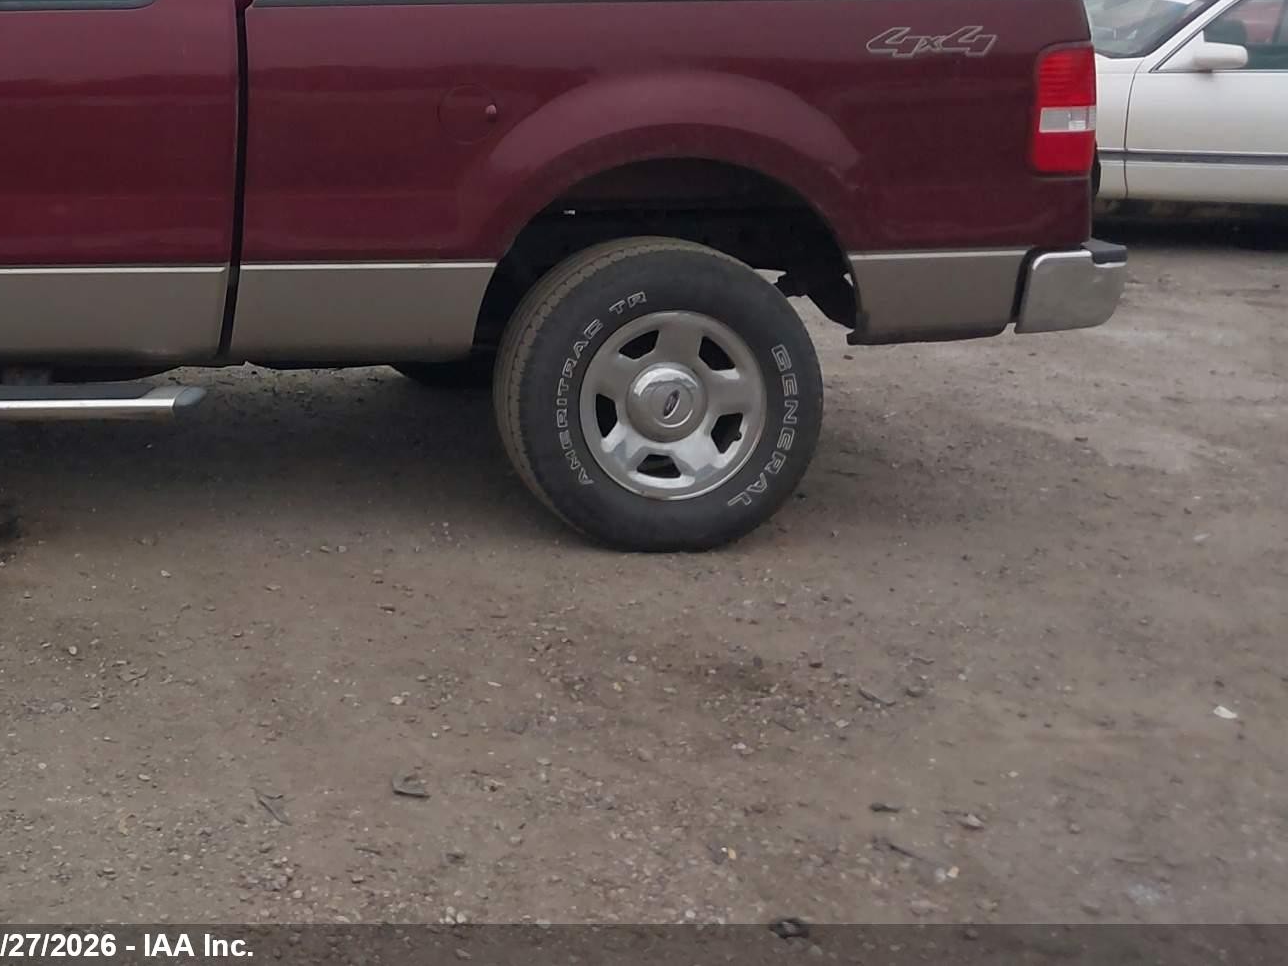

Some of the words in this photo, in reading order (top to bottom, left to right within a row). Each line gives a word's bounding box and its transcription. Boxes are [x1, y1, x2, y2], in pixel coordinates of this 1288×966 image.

[556, 318, 604, 486] AMERITRAC
[609, 291, 648, 315] TR
[727, 343, 799, 507] GENERAL
